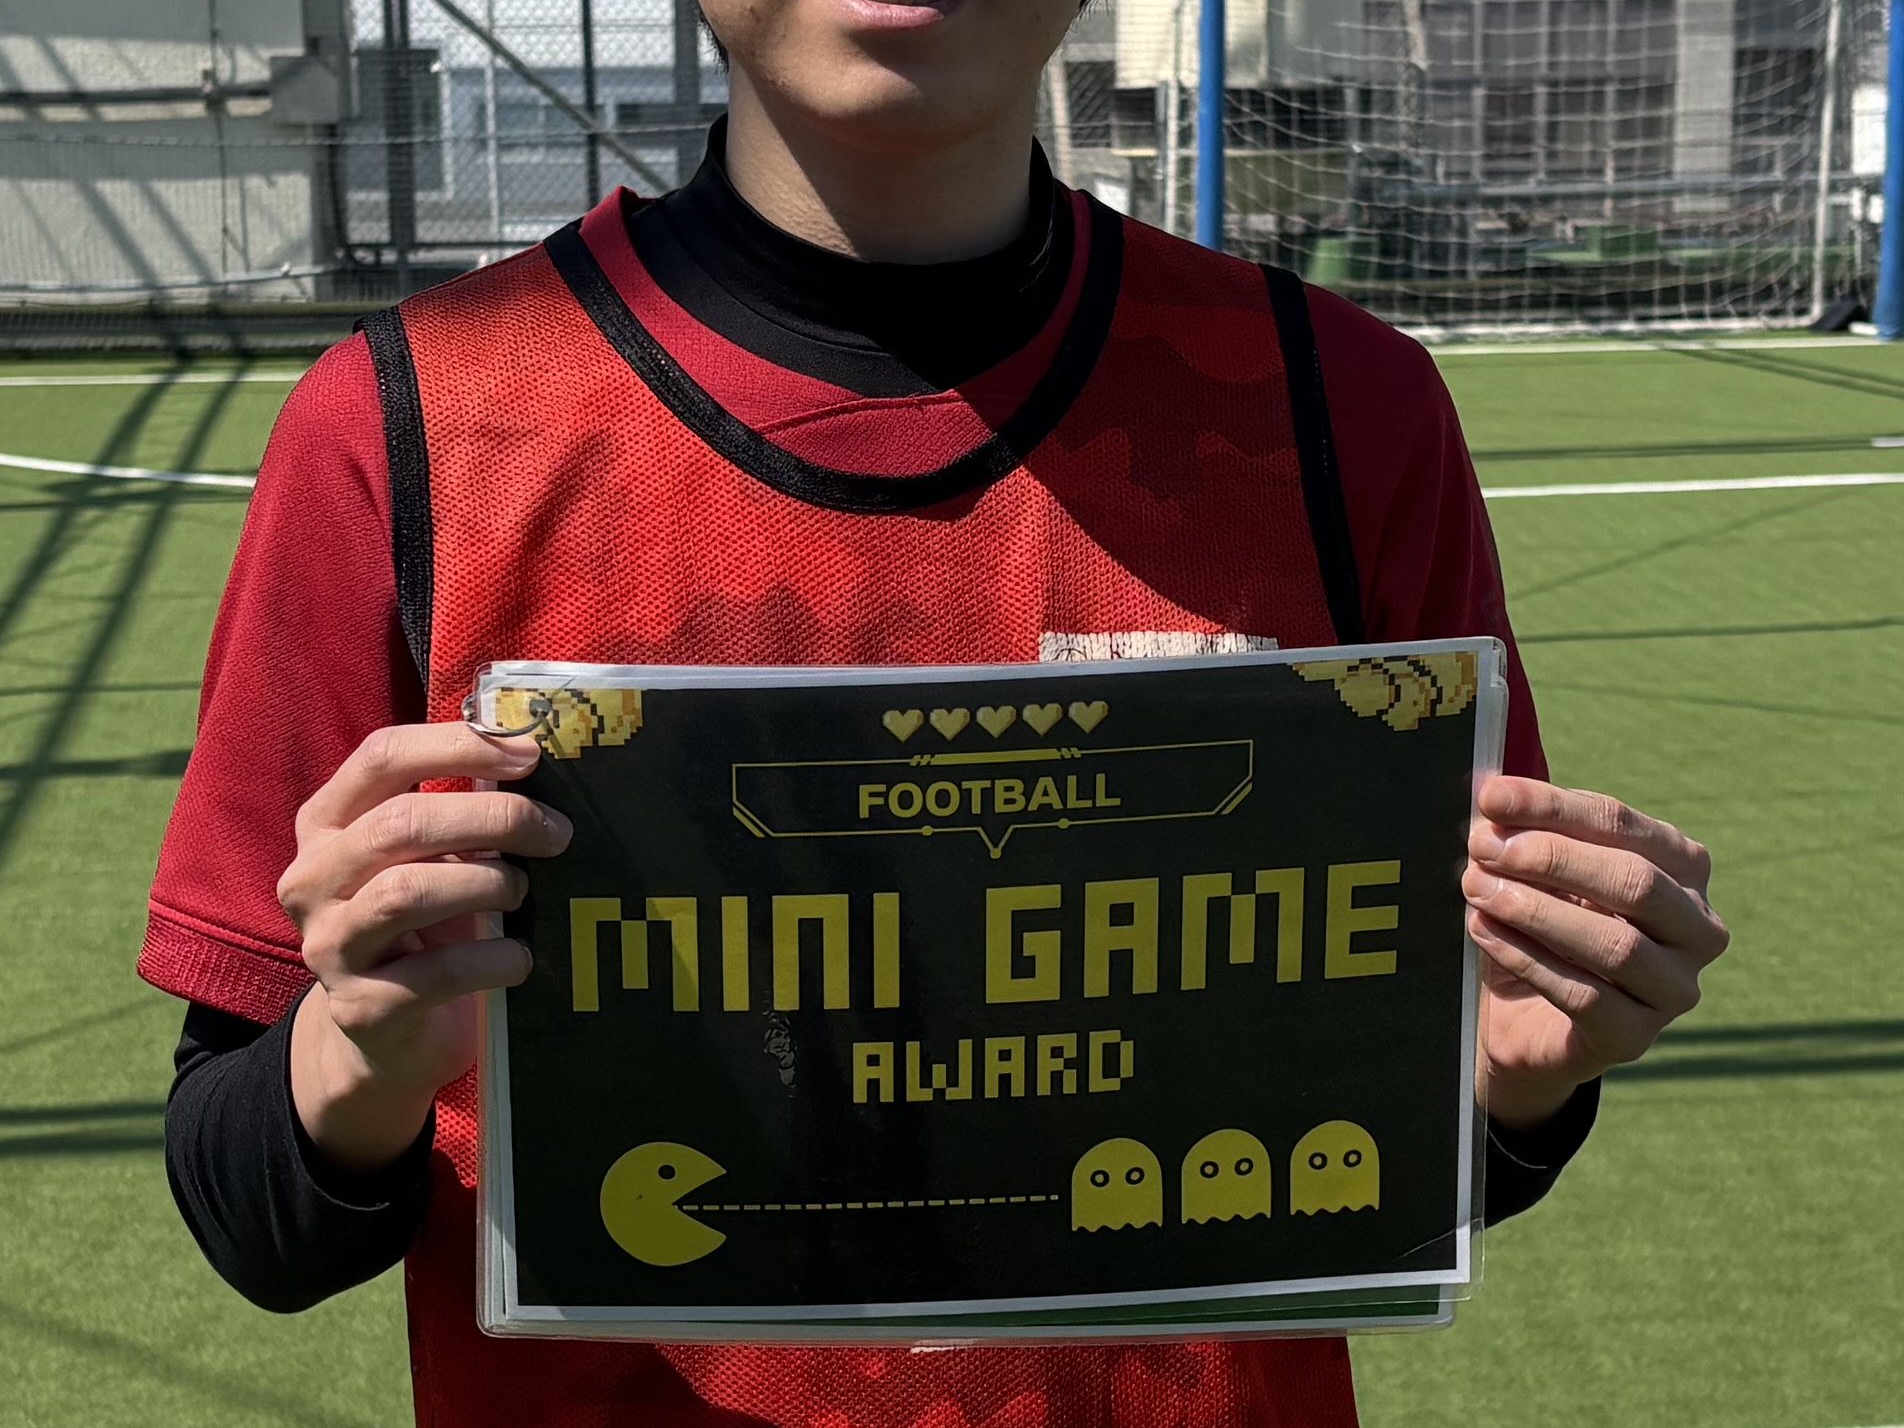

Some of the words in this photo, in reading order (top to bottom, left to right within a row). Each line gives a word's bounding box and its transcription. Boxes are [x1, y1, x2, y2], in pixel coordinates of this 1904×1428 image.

[857, 774, 1122, 819] FOOTBALL
[568, 892, 902, 1013] MINI
[984, 858, 1402, 1005] GAME
[851, 1028, 1137, 1105] AWARD
